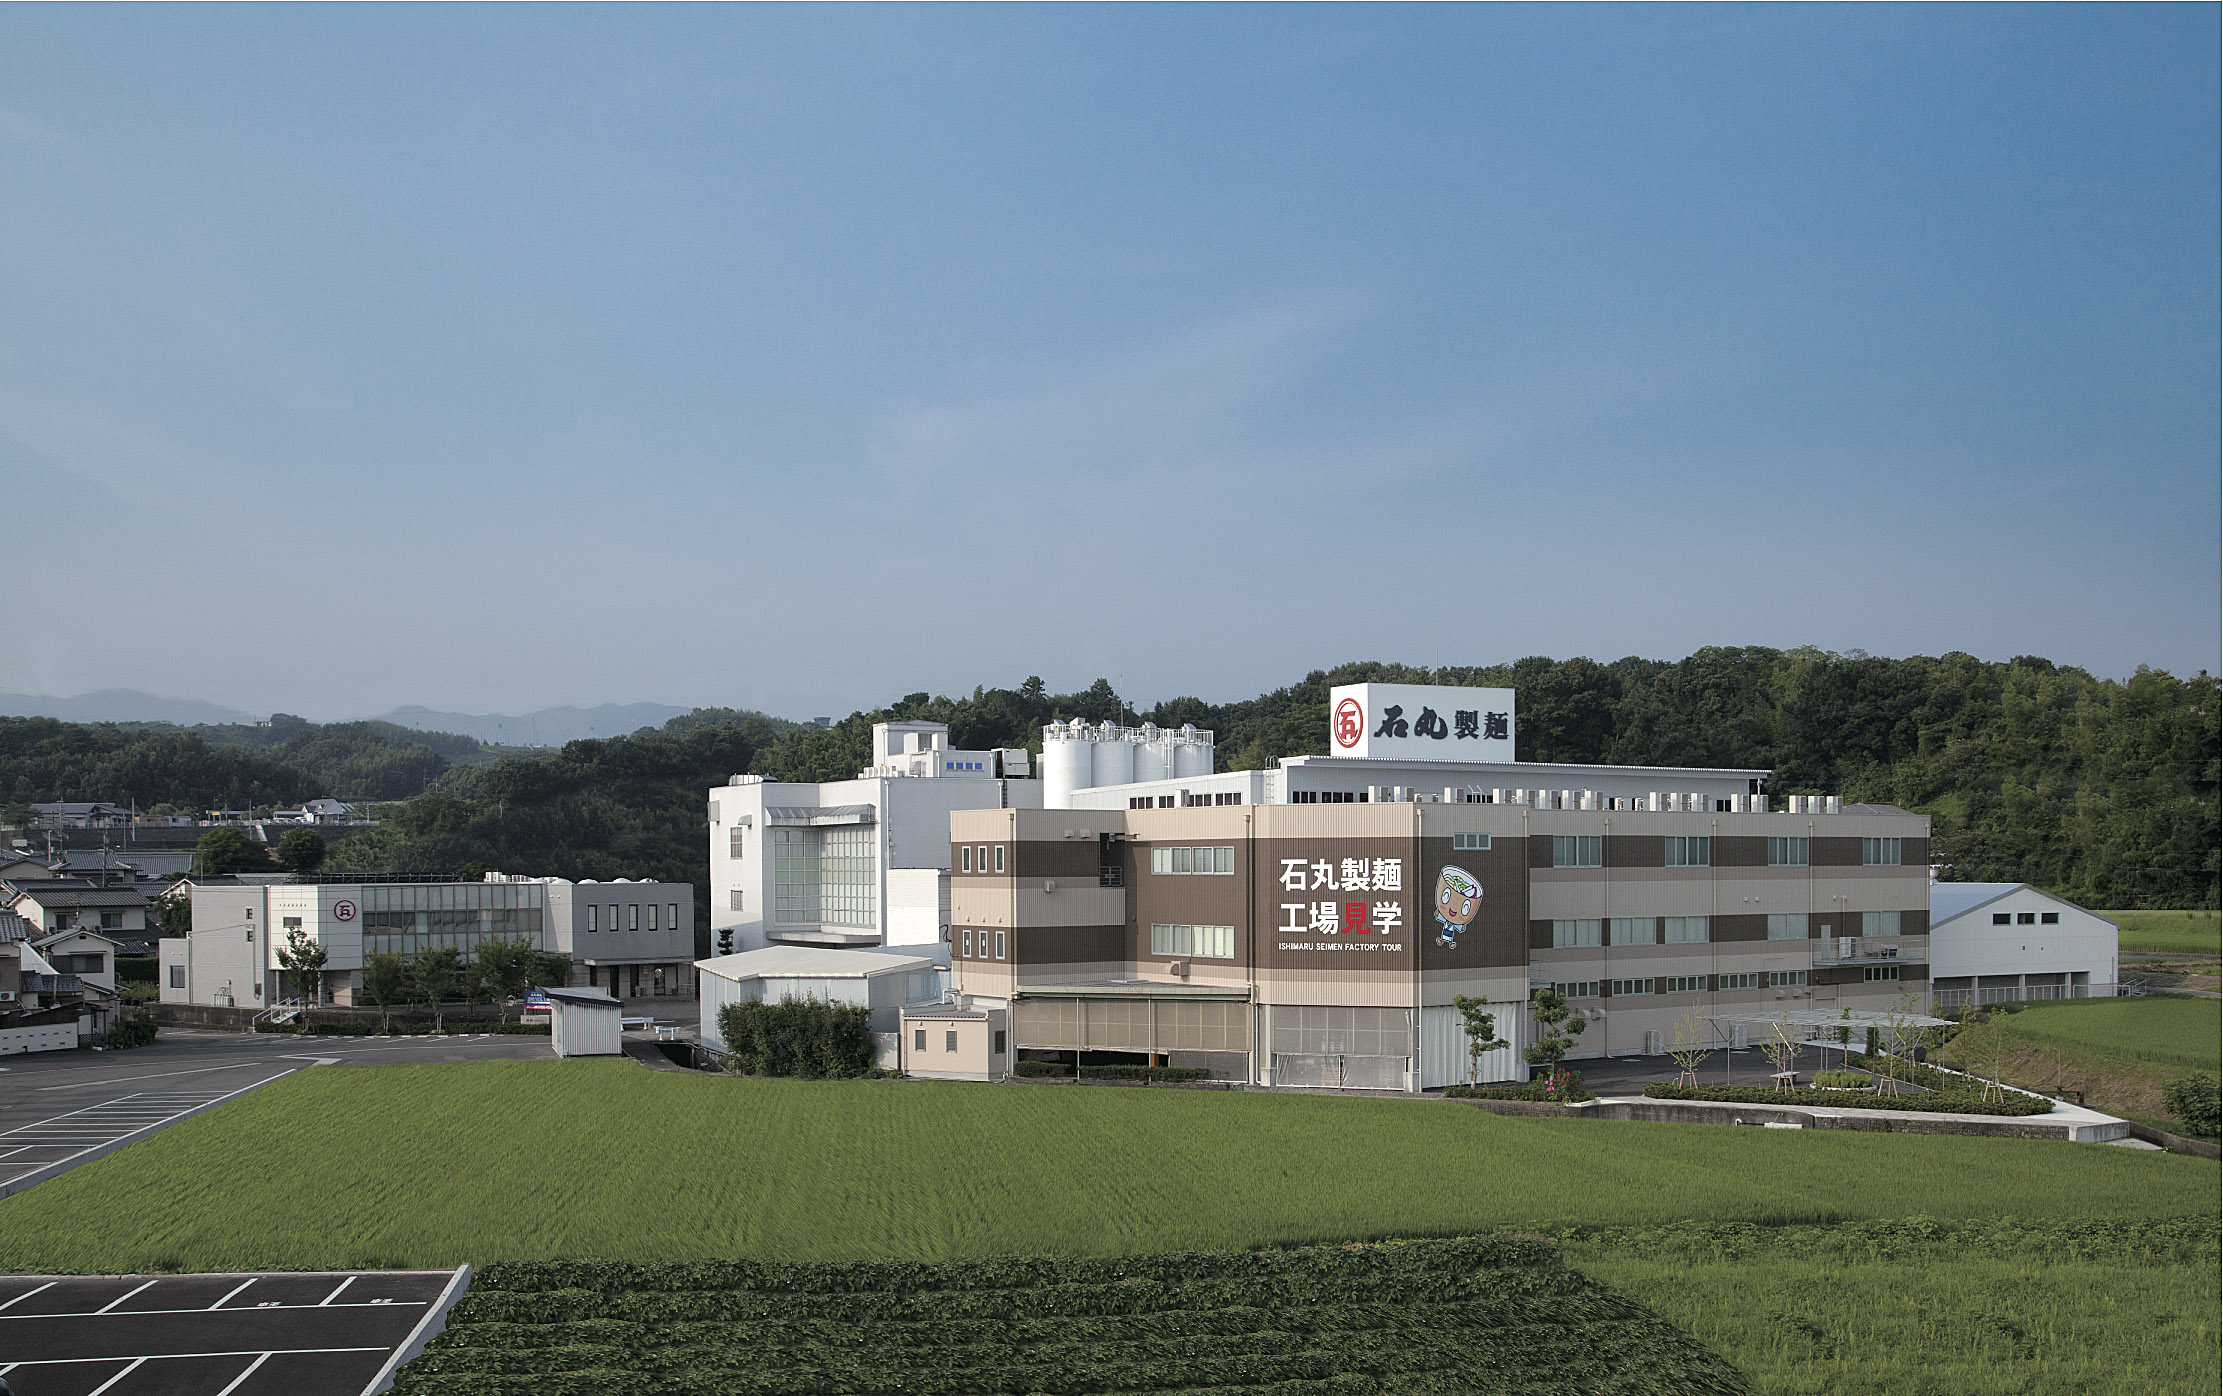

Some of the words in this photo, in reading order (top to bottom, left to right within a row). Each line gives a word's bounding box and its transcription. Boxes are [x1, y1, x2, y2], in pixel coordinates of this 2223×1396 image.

[1373, 704, 1509, 740] 石丸製麺
[1279, 857, 1402, 892] 石丸製麺
[1278, 900, 1403, 935] 工場見学
[1278, 942, 1314, 951] ISHIMARU
[1316, 942, 1343, 951] SEIMEN
[1345, 943, 1380, 951] FACTORY
[1382, 943, 1402, 952] TOUR
